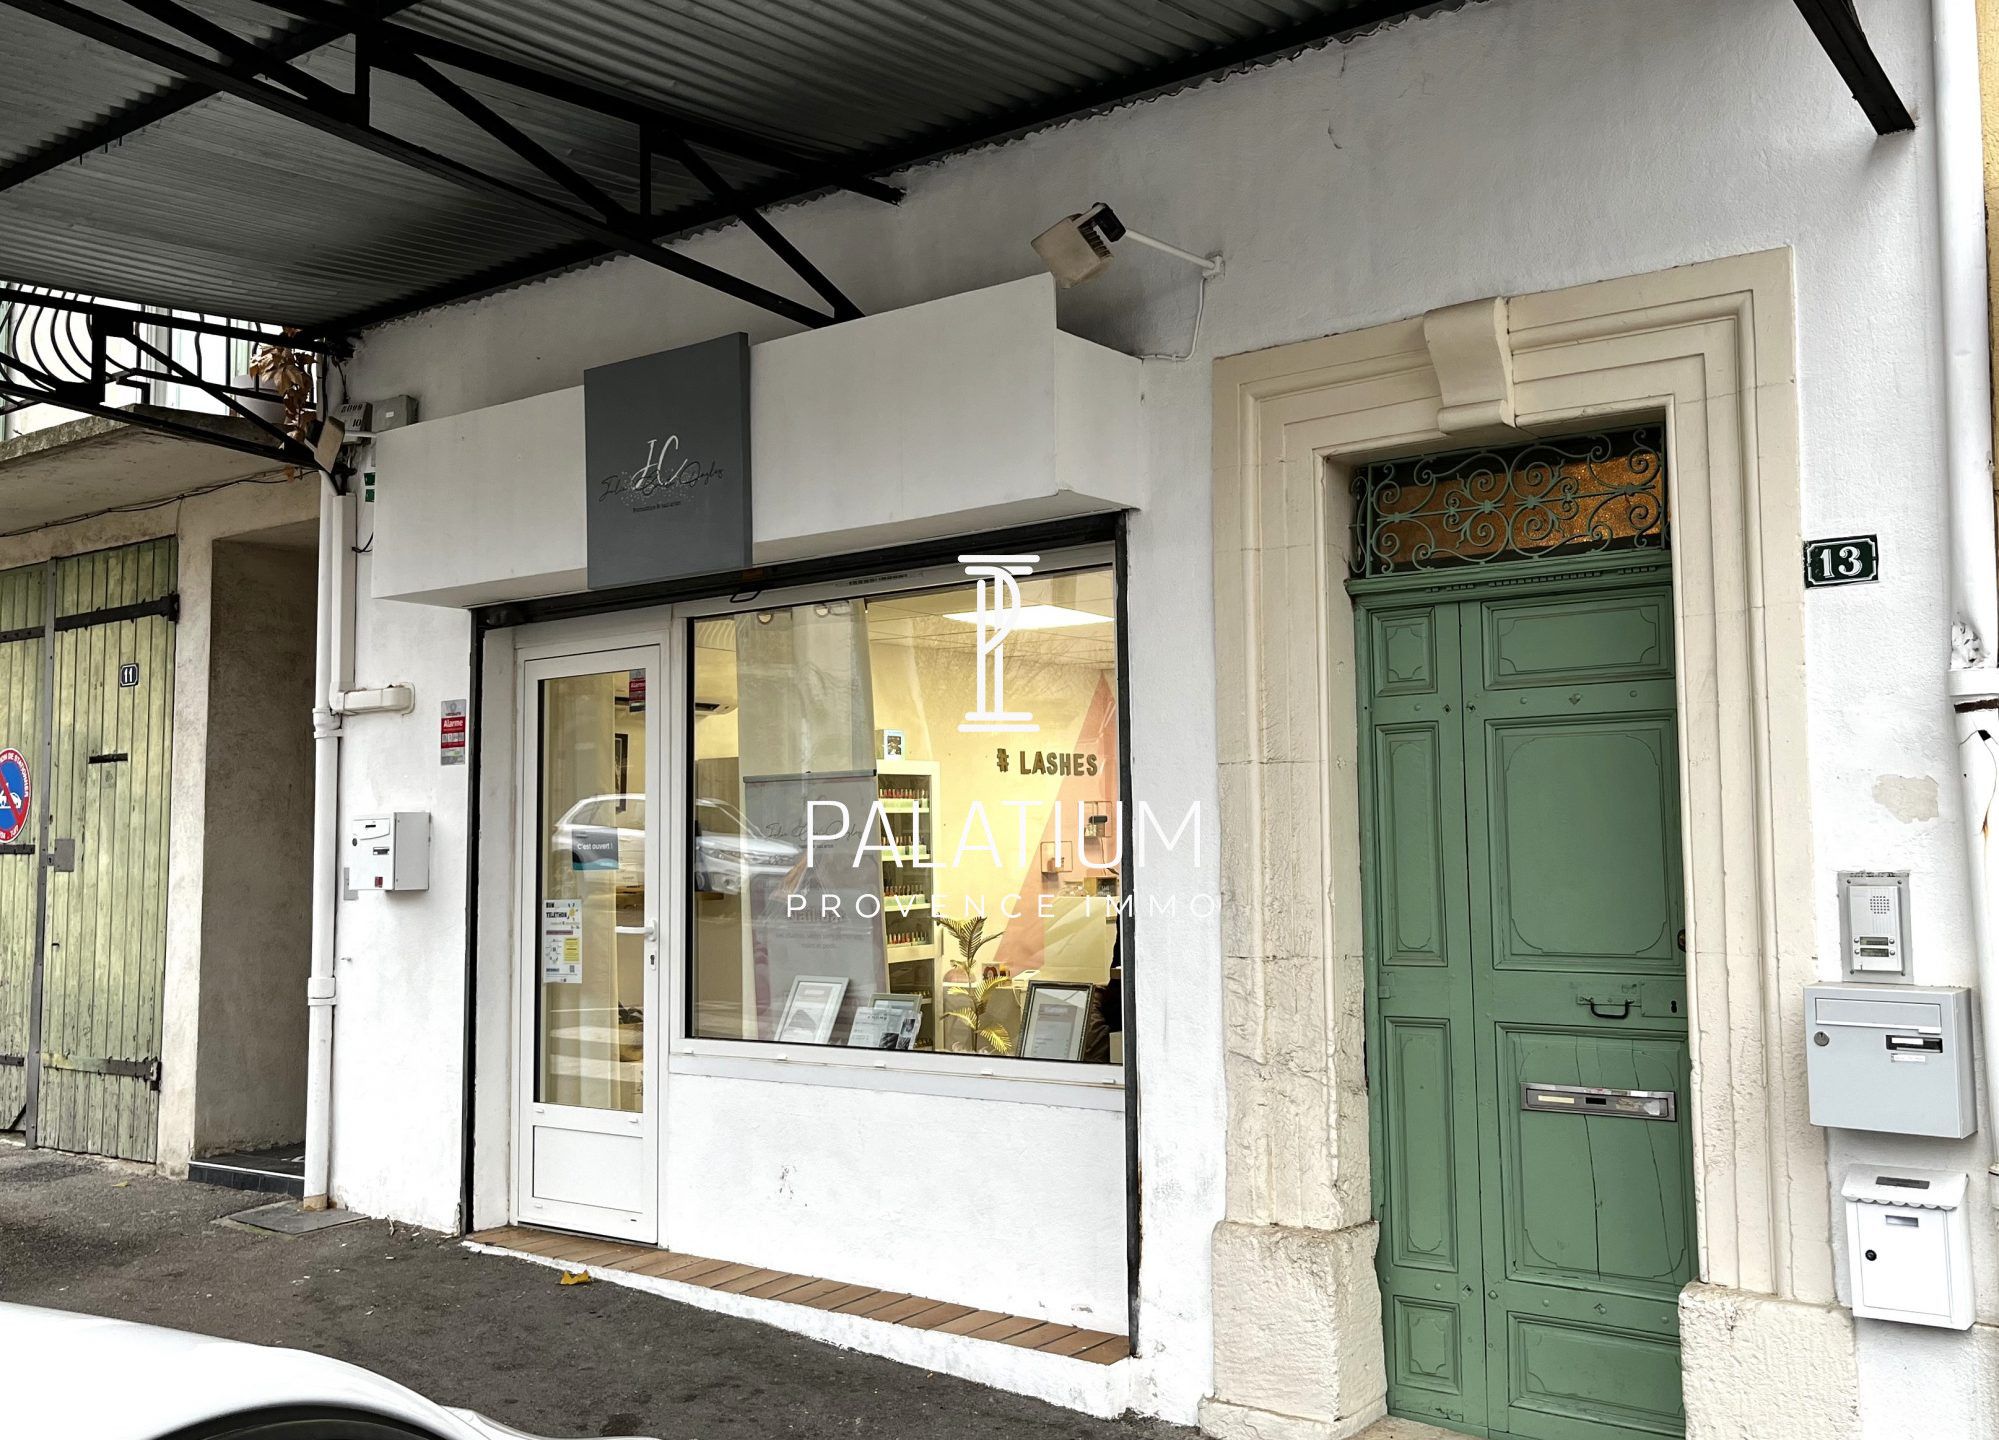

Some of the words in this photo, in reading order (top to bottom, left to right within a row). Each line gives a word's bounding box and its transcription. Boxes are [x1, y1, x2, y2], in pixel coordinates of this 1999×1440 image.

[1820, 546, 1862, 578] 13
[124, 667, 133, 683] 11
[443, 718, 463, 727] Alarme
[1019, 751, 1098, 776] LASHES
